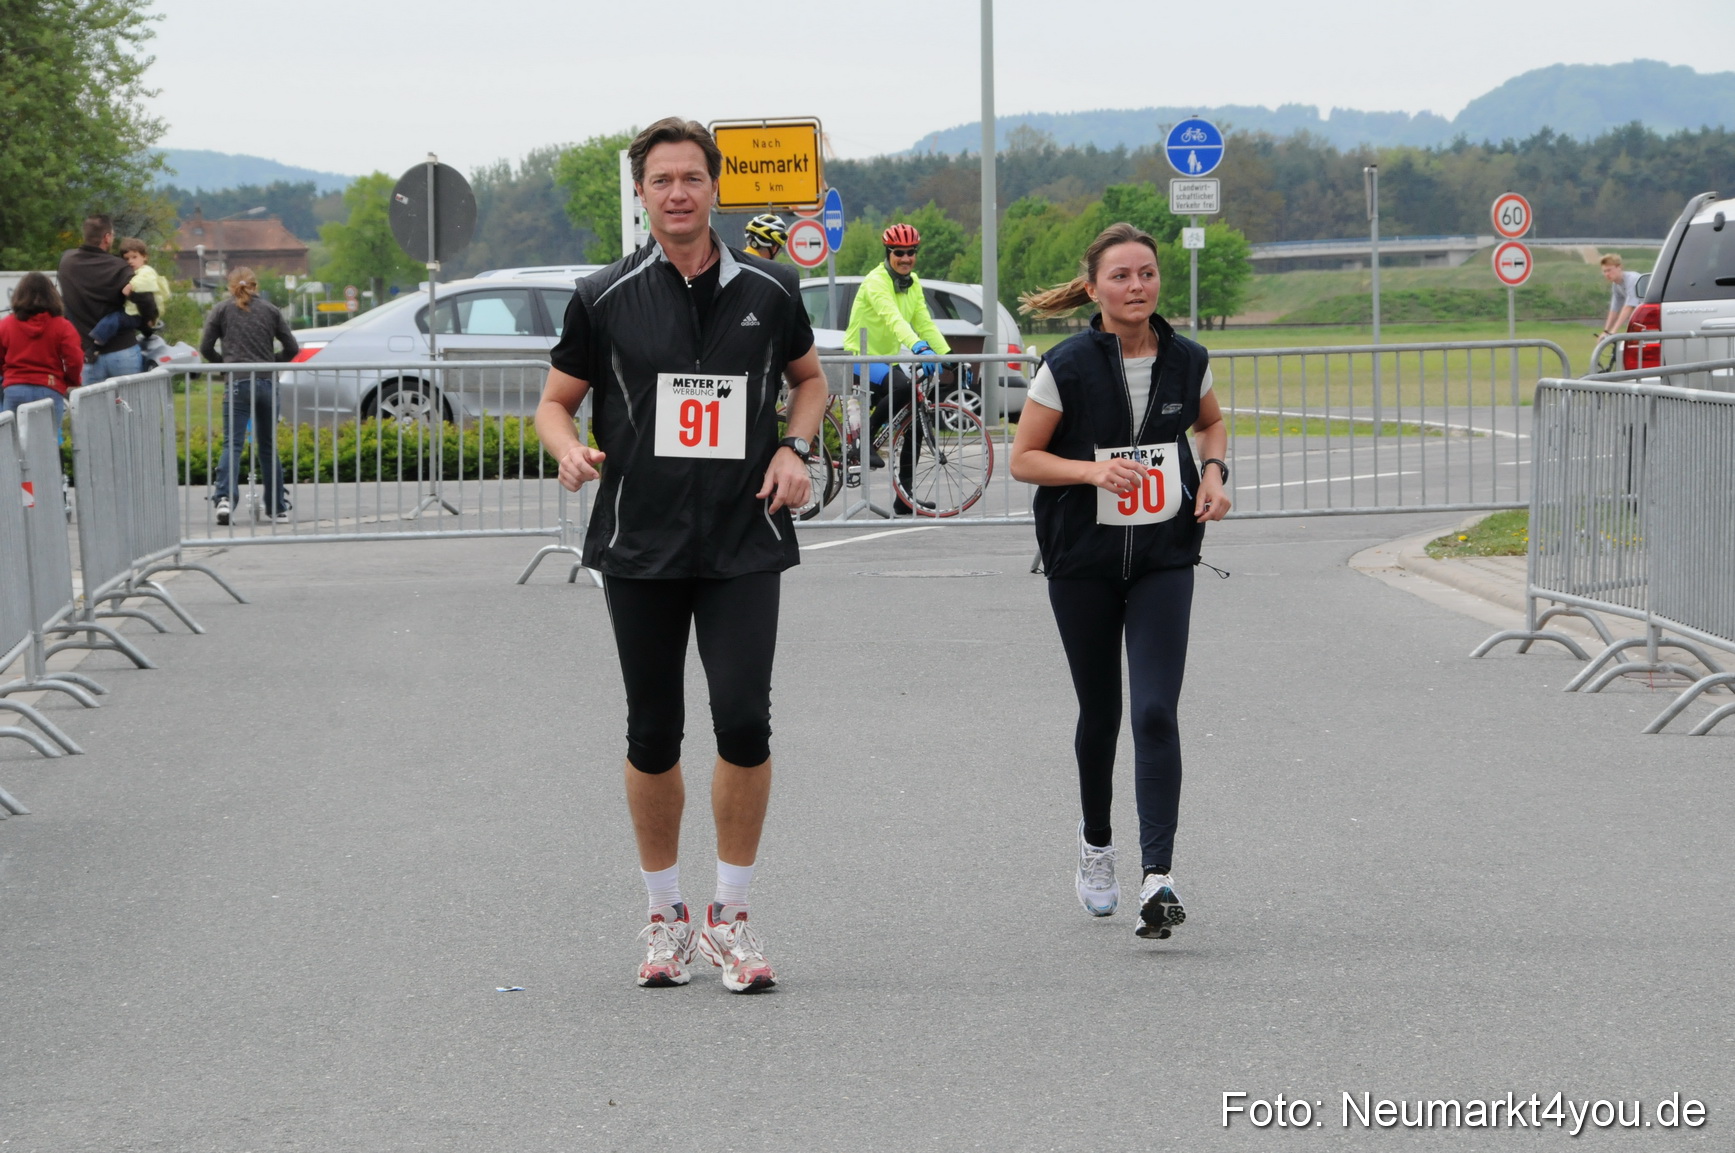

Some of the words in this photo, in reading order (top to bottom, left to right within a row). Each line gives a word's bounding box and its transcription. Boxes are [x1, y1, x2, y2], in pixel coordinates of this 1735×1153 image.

[752, 138, 781, 149] Nach
[725, 153, 809, 175] Neumarkt
[754, 181, 761, 192] 5
[769, 182, 784, 192] km
[1179, 184, 1211, 192] Landwirt-
[1175, 192, 1214, 201] schaftlicher
[1203, 201, 1215, 209] frei
[1502, 206, 1523, 226] 60
[673, 378, 714, 389] MEYER
[673, 388, 715, 397] WERBUNG
[679, 398, 720, 448] 91
